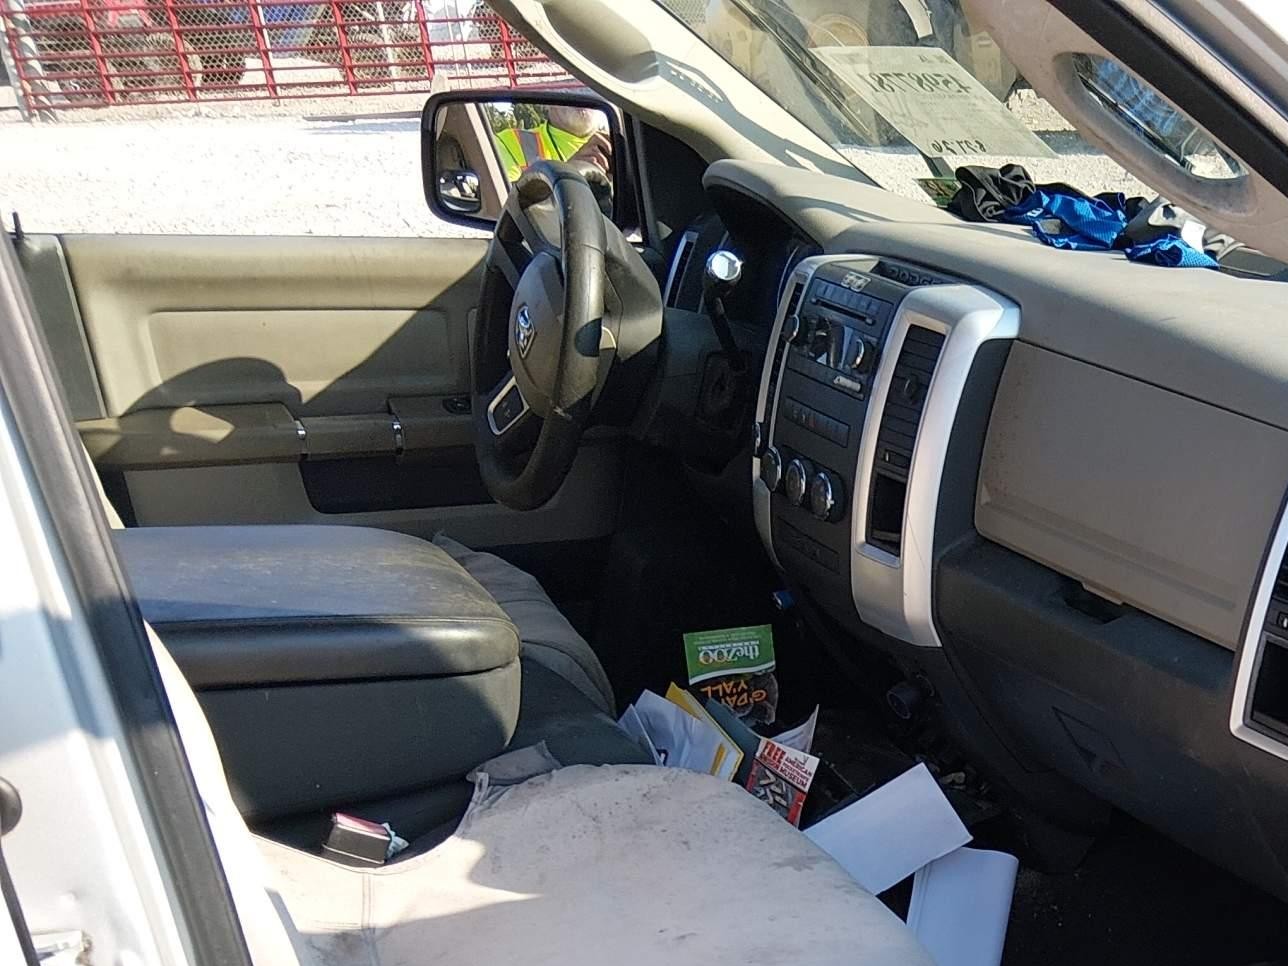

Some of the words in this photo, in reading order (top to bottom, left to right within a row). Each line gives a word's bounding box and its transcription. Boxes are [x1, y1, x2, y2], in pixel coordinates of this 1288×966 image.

[700, 679, 748, 700] Y'ALL
[720, 688, 767, 707] G'DA
[763, 740, 787, 764] FREE
[780, 766, 809, 788] MUSEUM
[783, 756, 813, 777] AMERICAN
